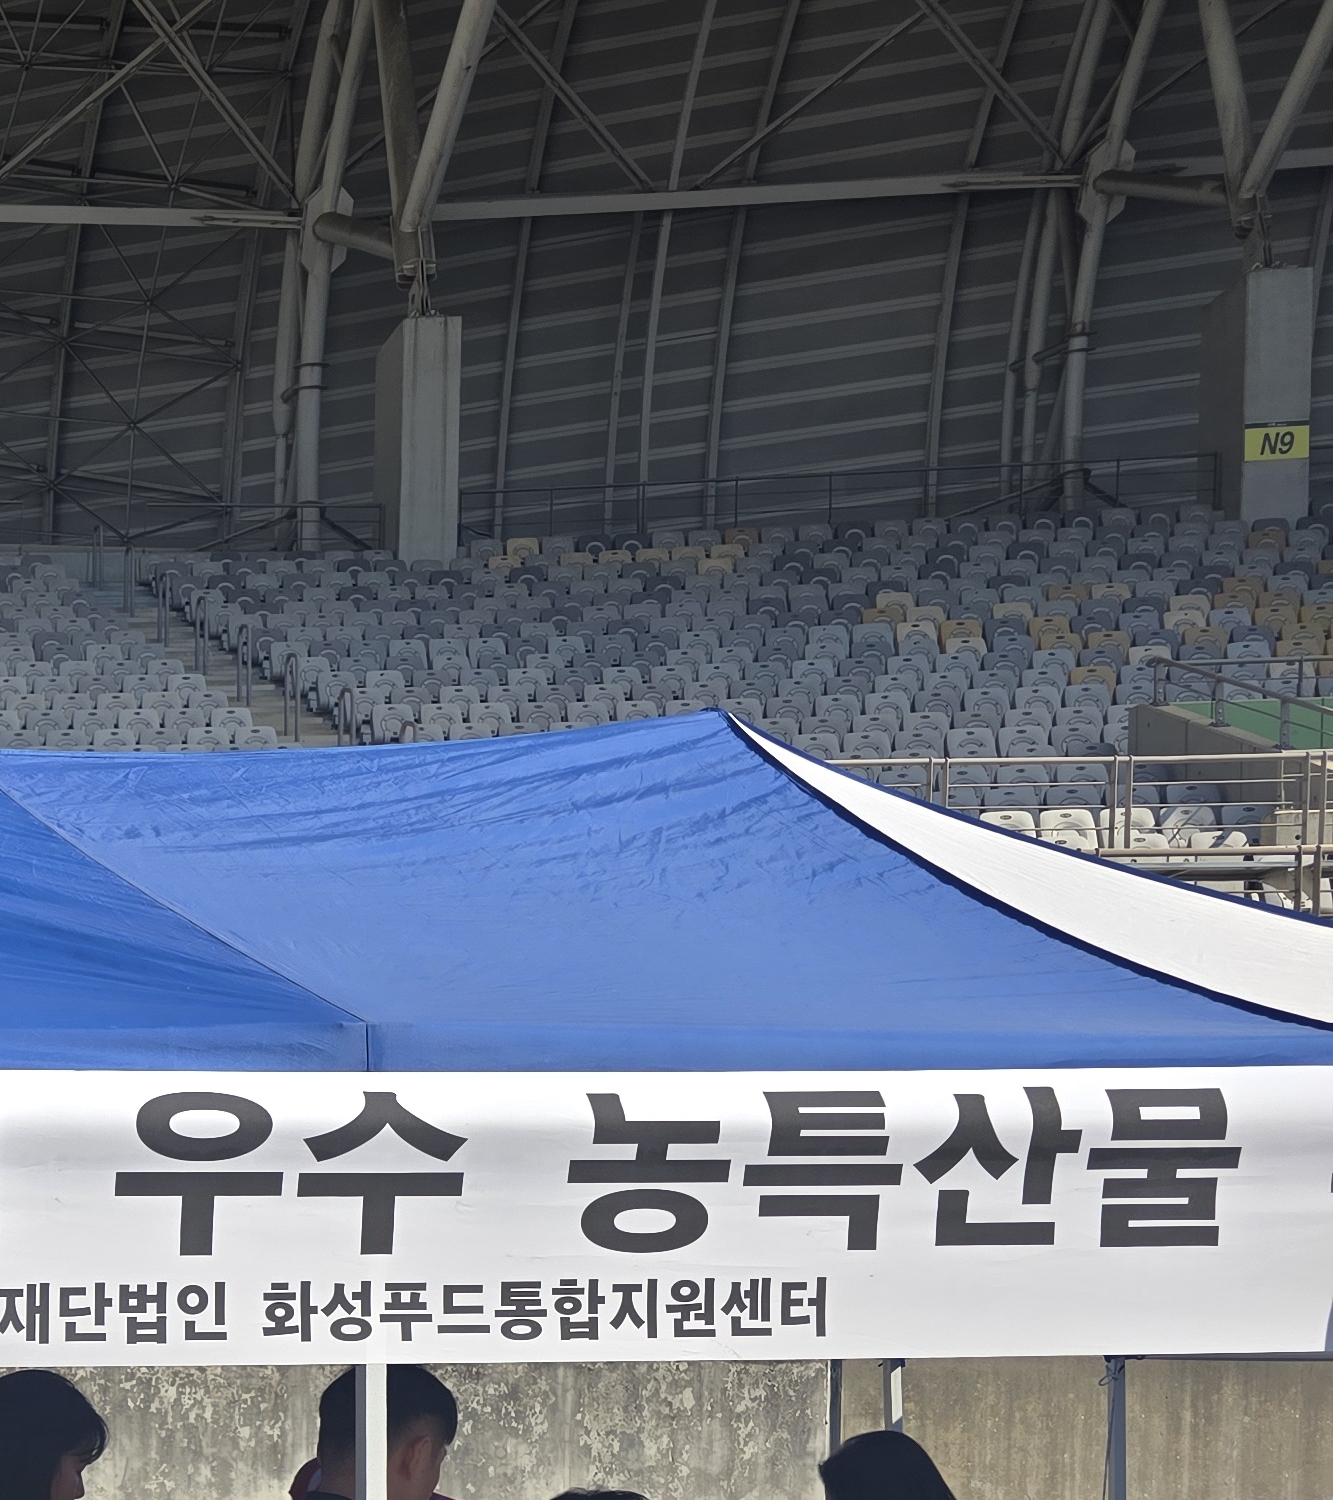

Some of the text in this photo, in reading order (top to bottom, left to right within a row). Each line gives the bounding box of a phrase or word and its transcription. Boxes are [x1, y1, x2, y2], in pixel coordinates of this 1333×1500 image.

[1259, 430, 1295, 456] N9
[114, 1090, 470, 1257] 우수
[567, 1086, 1242, 1256] 농특산물
[261, 1276, 829, 1343] 화성푸드통합지원센터
